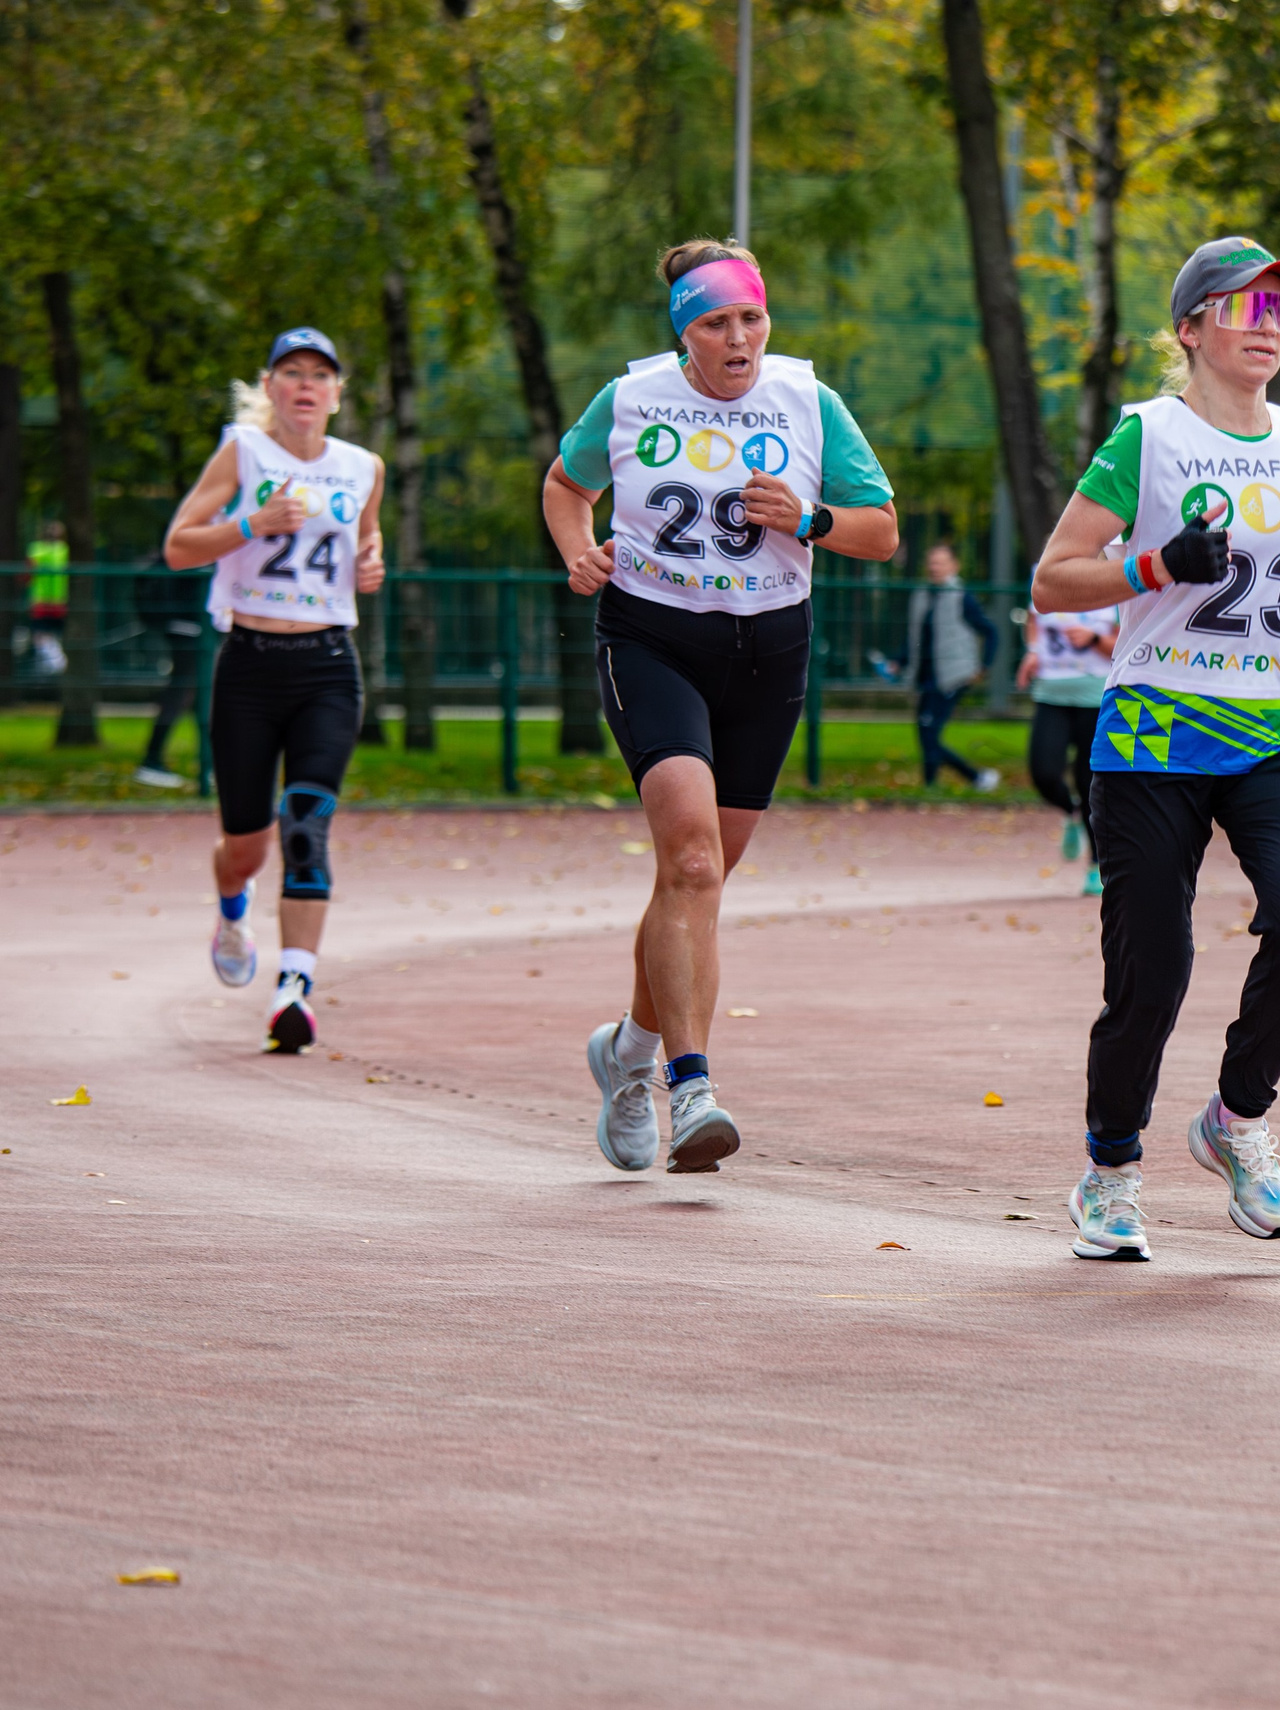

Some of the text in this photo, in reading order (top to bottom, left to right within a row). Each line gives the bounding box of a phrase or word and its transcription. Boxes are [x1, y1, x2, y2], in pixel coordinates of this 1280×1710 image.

[637, 404, 790, 430] VMARAFONE
[645, 481, 767, 561] 29
[258, 532, 340, 585] 24
[632, 556, 798, 592] VMARAFONE.CLUB
